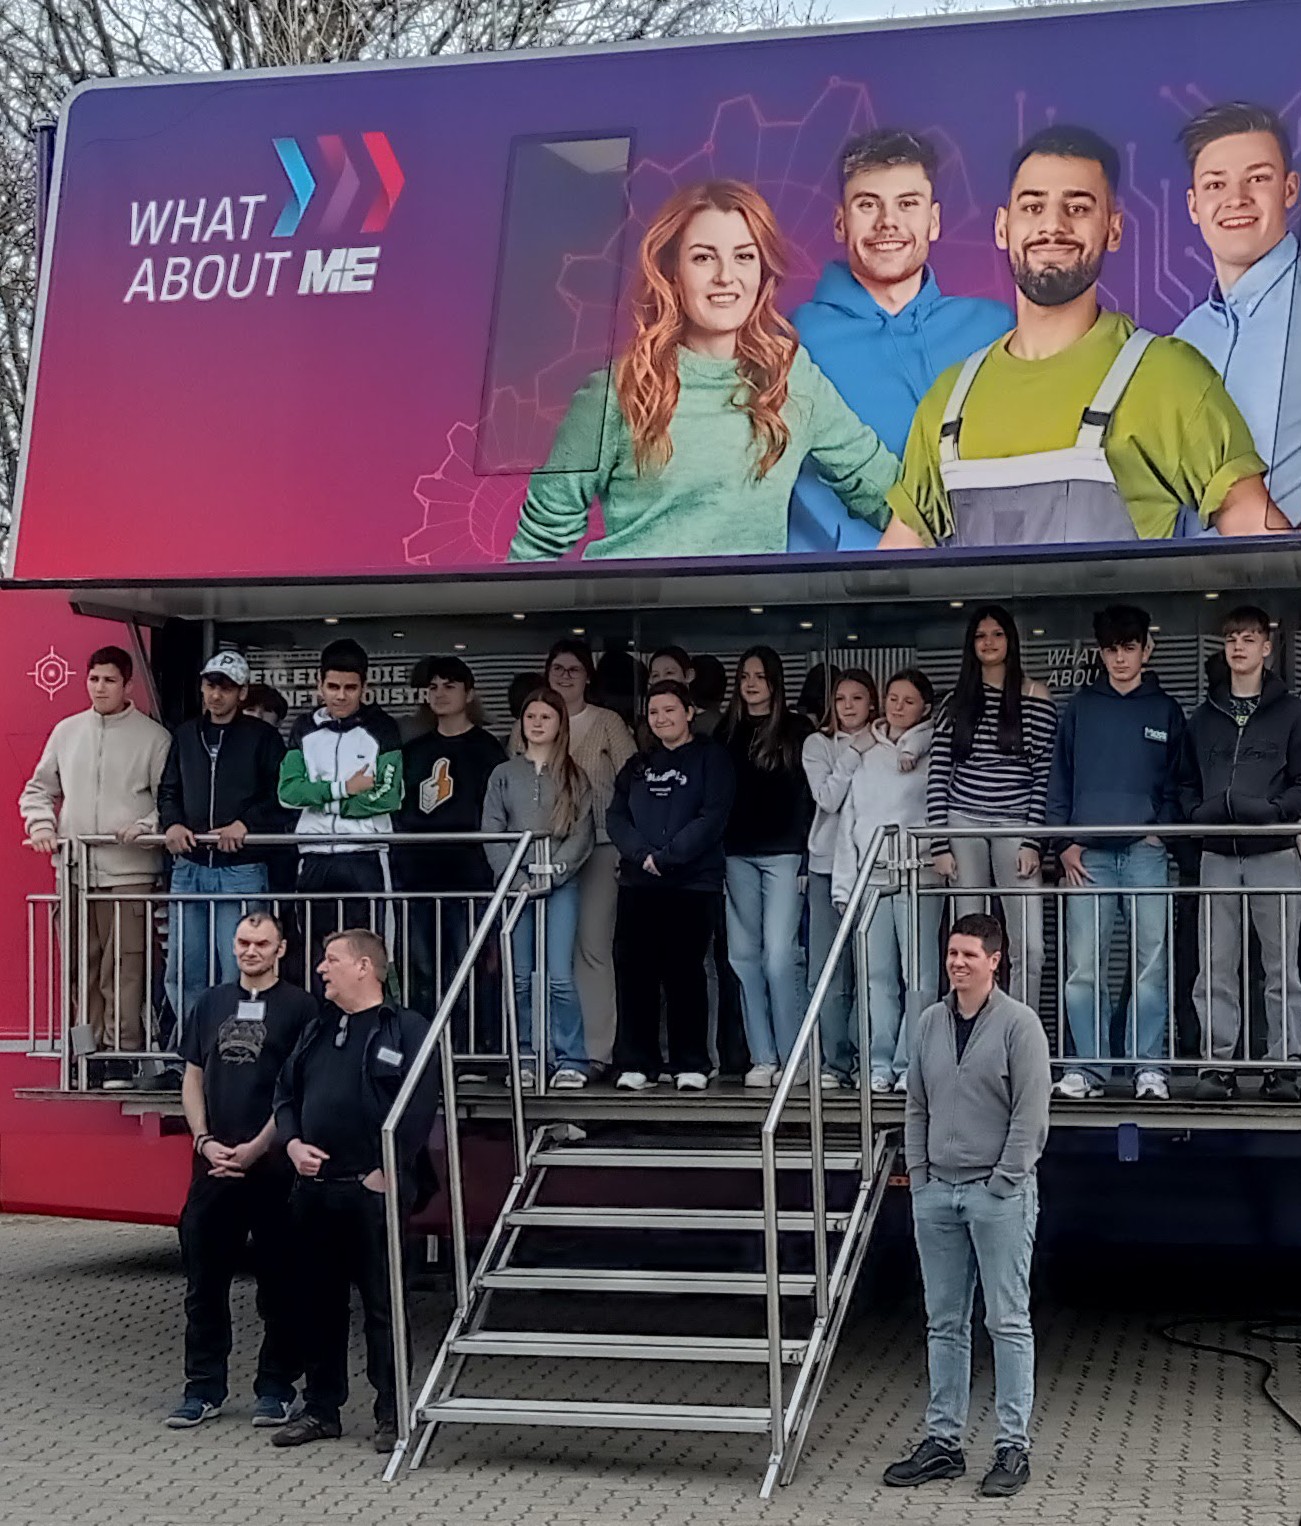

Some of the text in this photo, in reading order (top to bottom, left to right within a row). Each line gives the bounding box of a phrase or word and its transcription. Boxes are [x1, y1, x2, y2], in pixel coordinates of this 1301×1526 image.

[129, 193, 267, 246] WHAT
[123, 245, 381, 303] ABOUT ME
[1048, 647, 1101, 666] WHAT
[249, 667, 320, 686] EIG EI
[1046, 668, 1100, 687] ABOU
